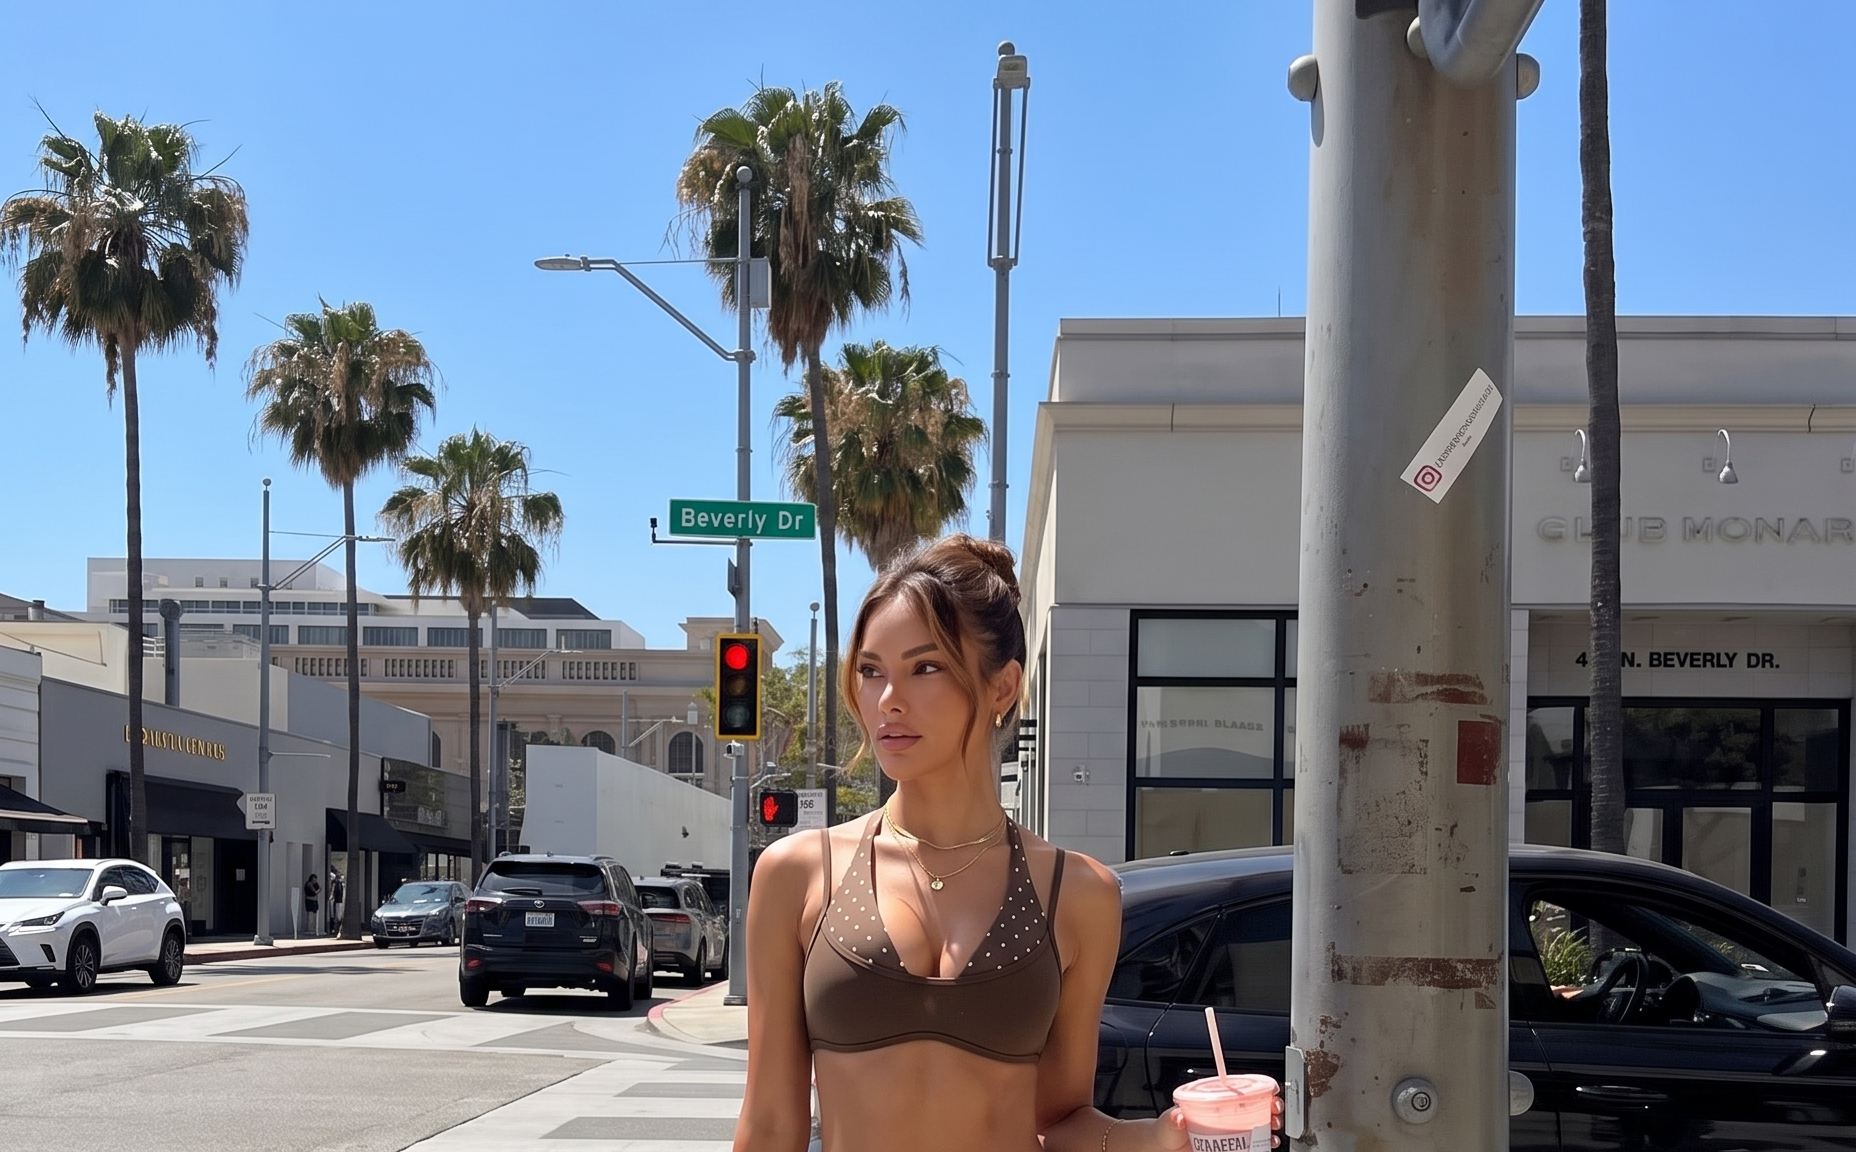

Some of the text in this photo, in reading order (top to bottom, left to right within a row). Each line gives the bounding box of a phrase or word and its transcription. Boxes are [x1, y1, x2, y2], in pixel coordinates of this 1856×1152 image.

[681, 508, 803, 534] Beverly Dr
[1621, 652, 1642, 668] N.
[1649, 652, 1738, 668] BEVERLY
[1746, 652, 1780, 669] DR.
